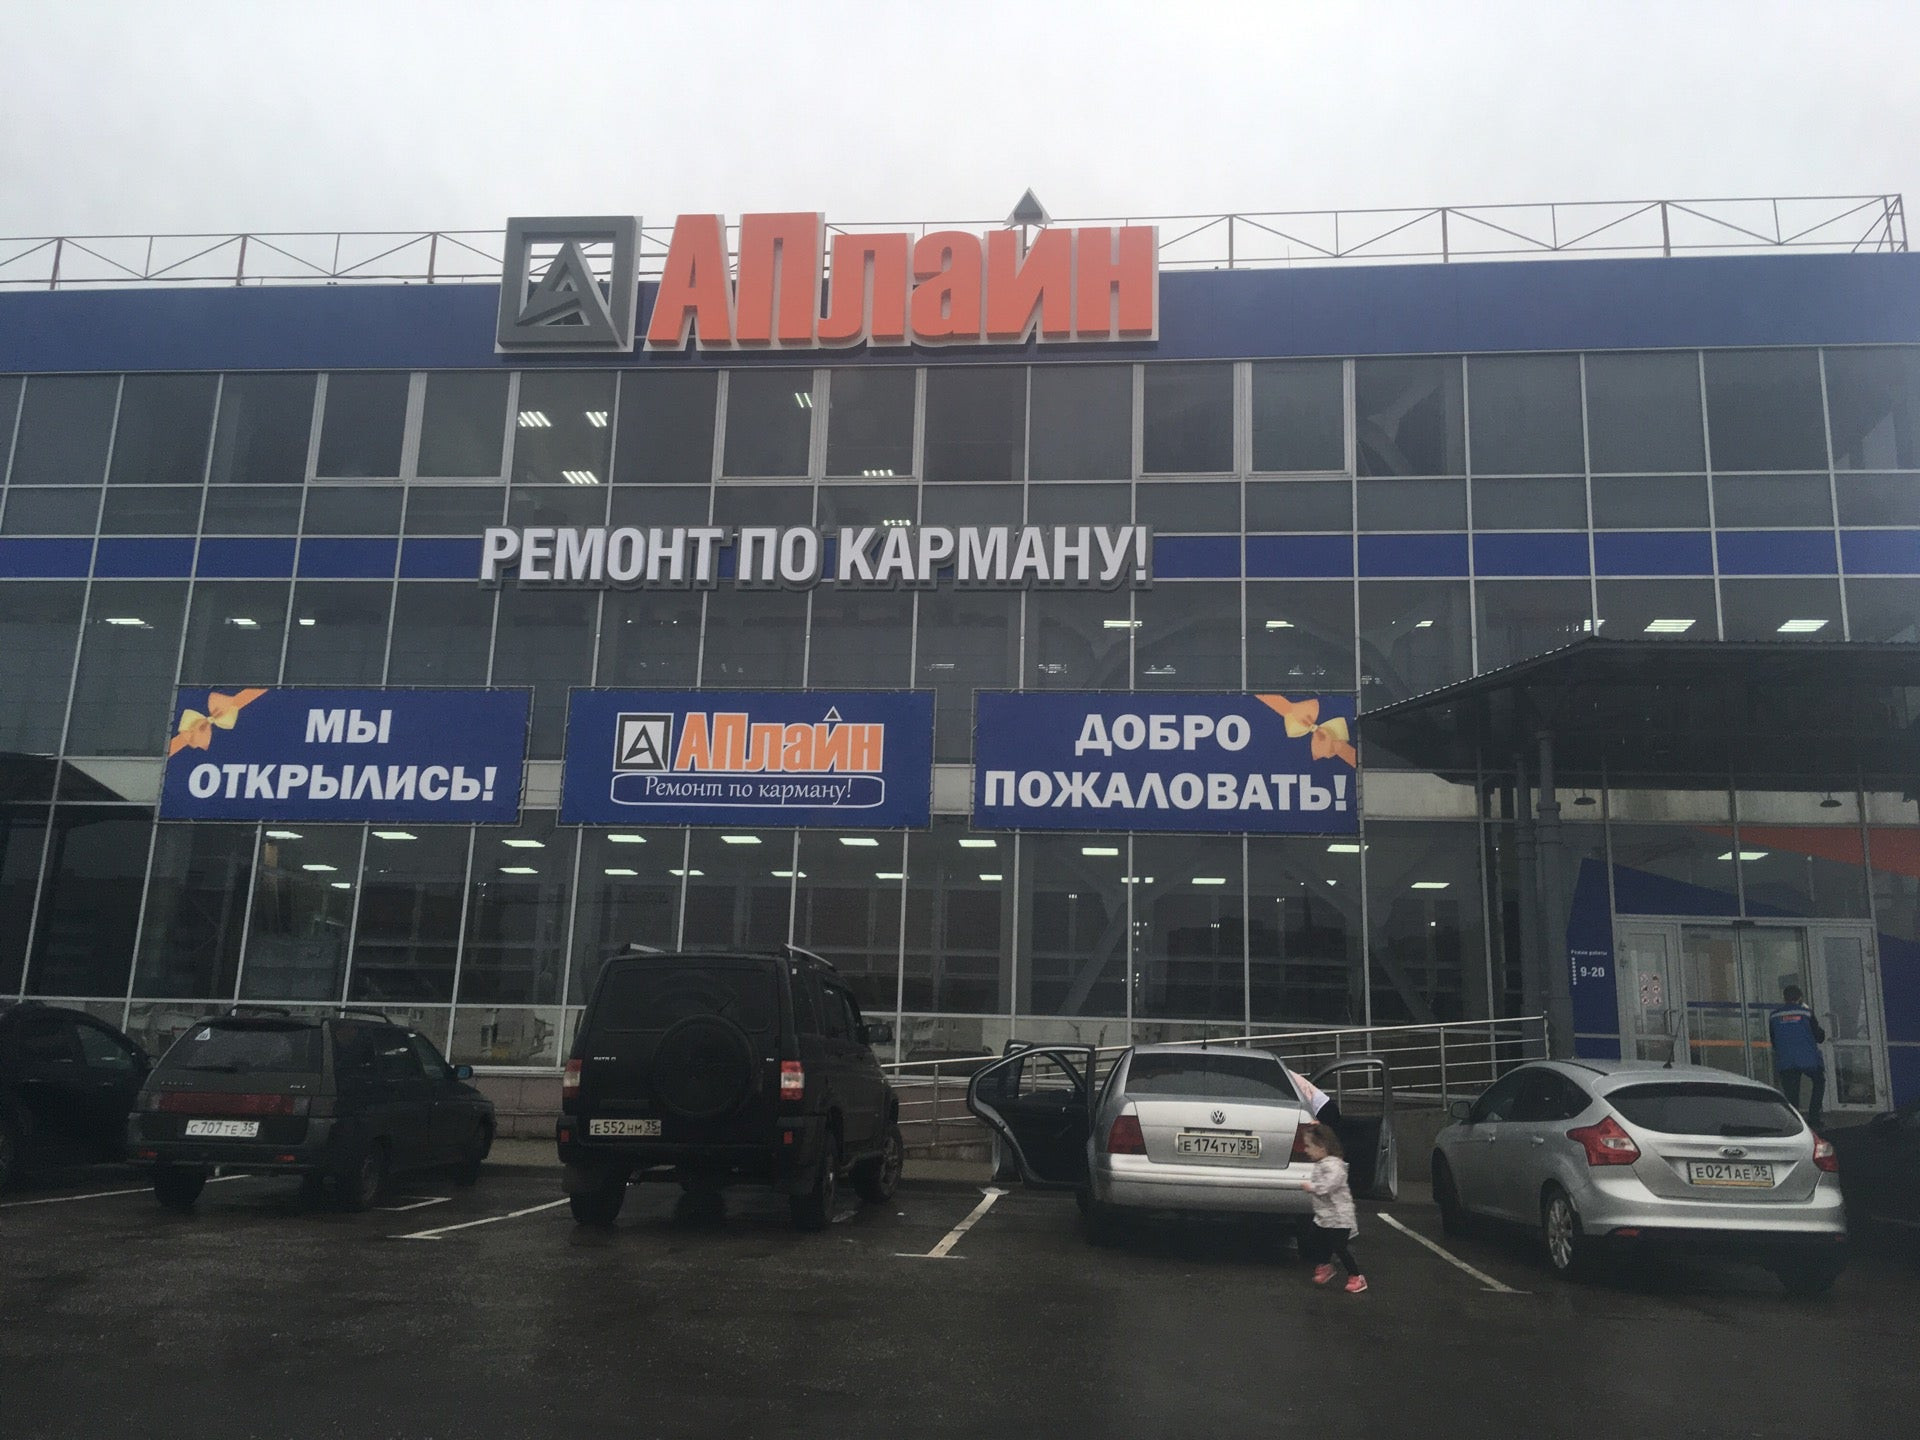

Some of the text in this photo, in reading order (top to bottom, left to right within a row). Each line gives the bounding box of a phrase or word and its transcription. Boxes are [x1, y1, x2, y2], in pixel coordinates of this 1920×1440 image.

[644, 187, 1159, 351] АПлайн
[480, 525, 1149, 583] РЕМОНТ ПО КАРМАНУ!
[304, 708, 393, 744] МЫ
[673, 706, 885, 773] АПлайн
[1074, 713, 1251, 757] ДОБРО
[187, 763, 498, 801] ОТКРЫЛИСЬ!
[644, 776, 852, 806] Ремонт по карману!
[984, 769, 1348, 812] ПОЖАЛОВАТЬ!
[1580, 966, 1605, 978] 9-20
